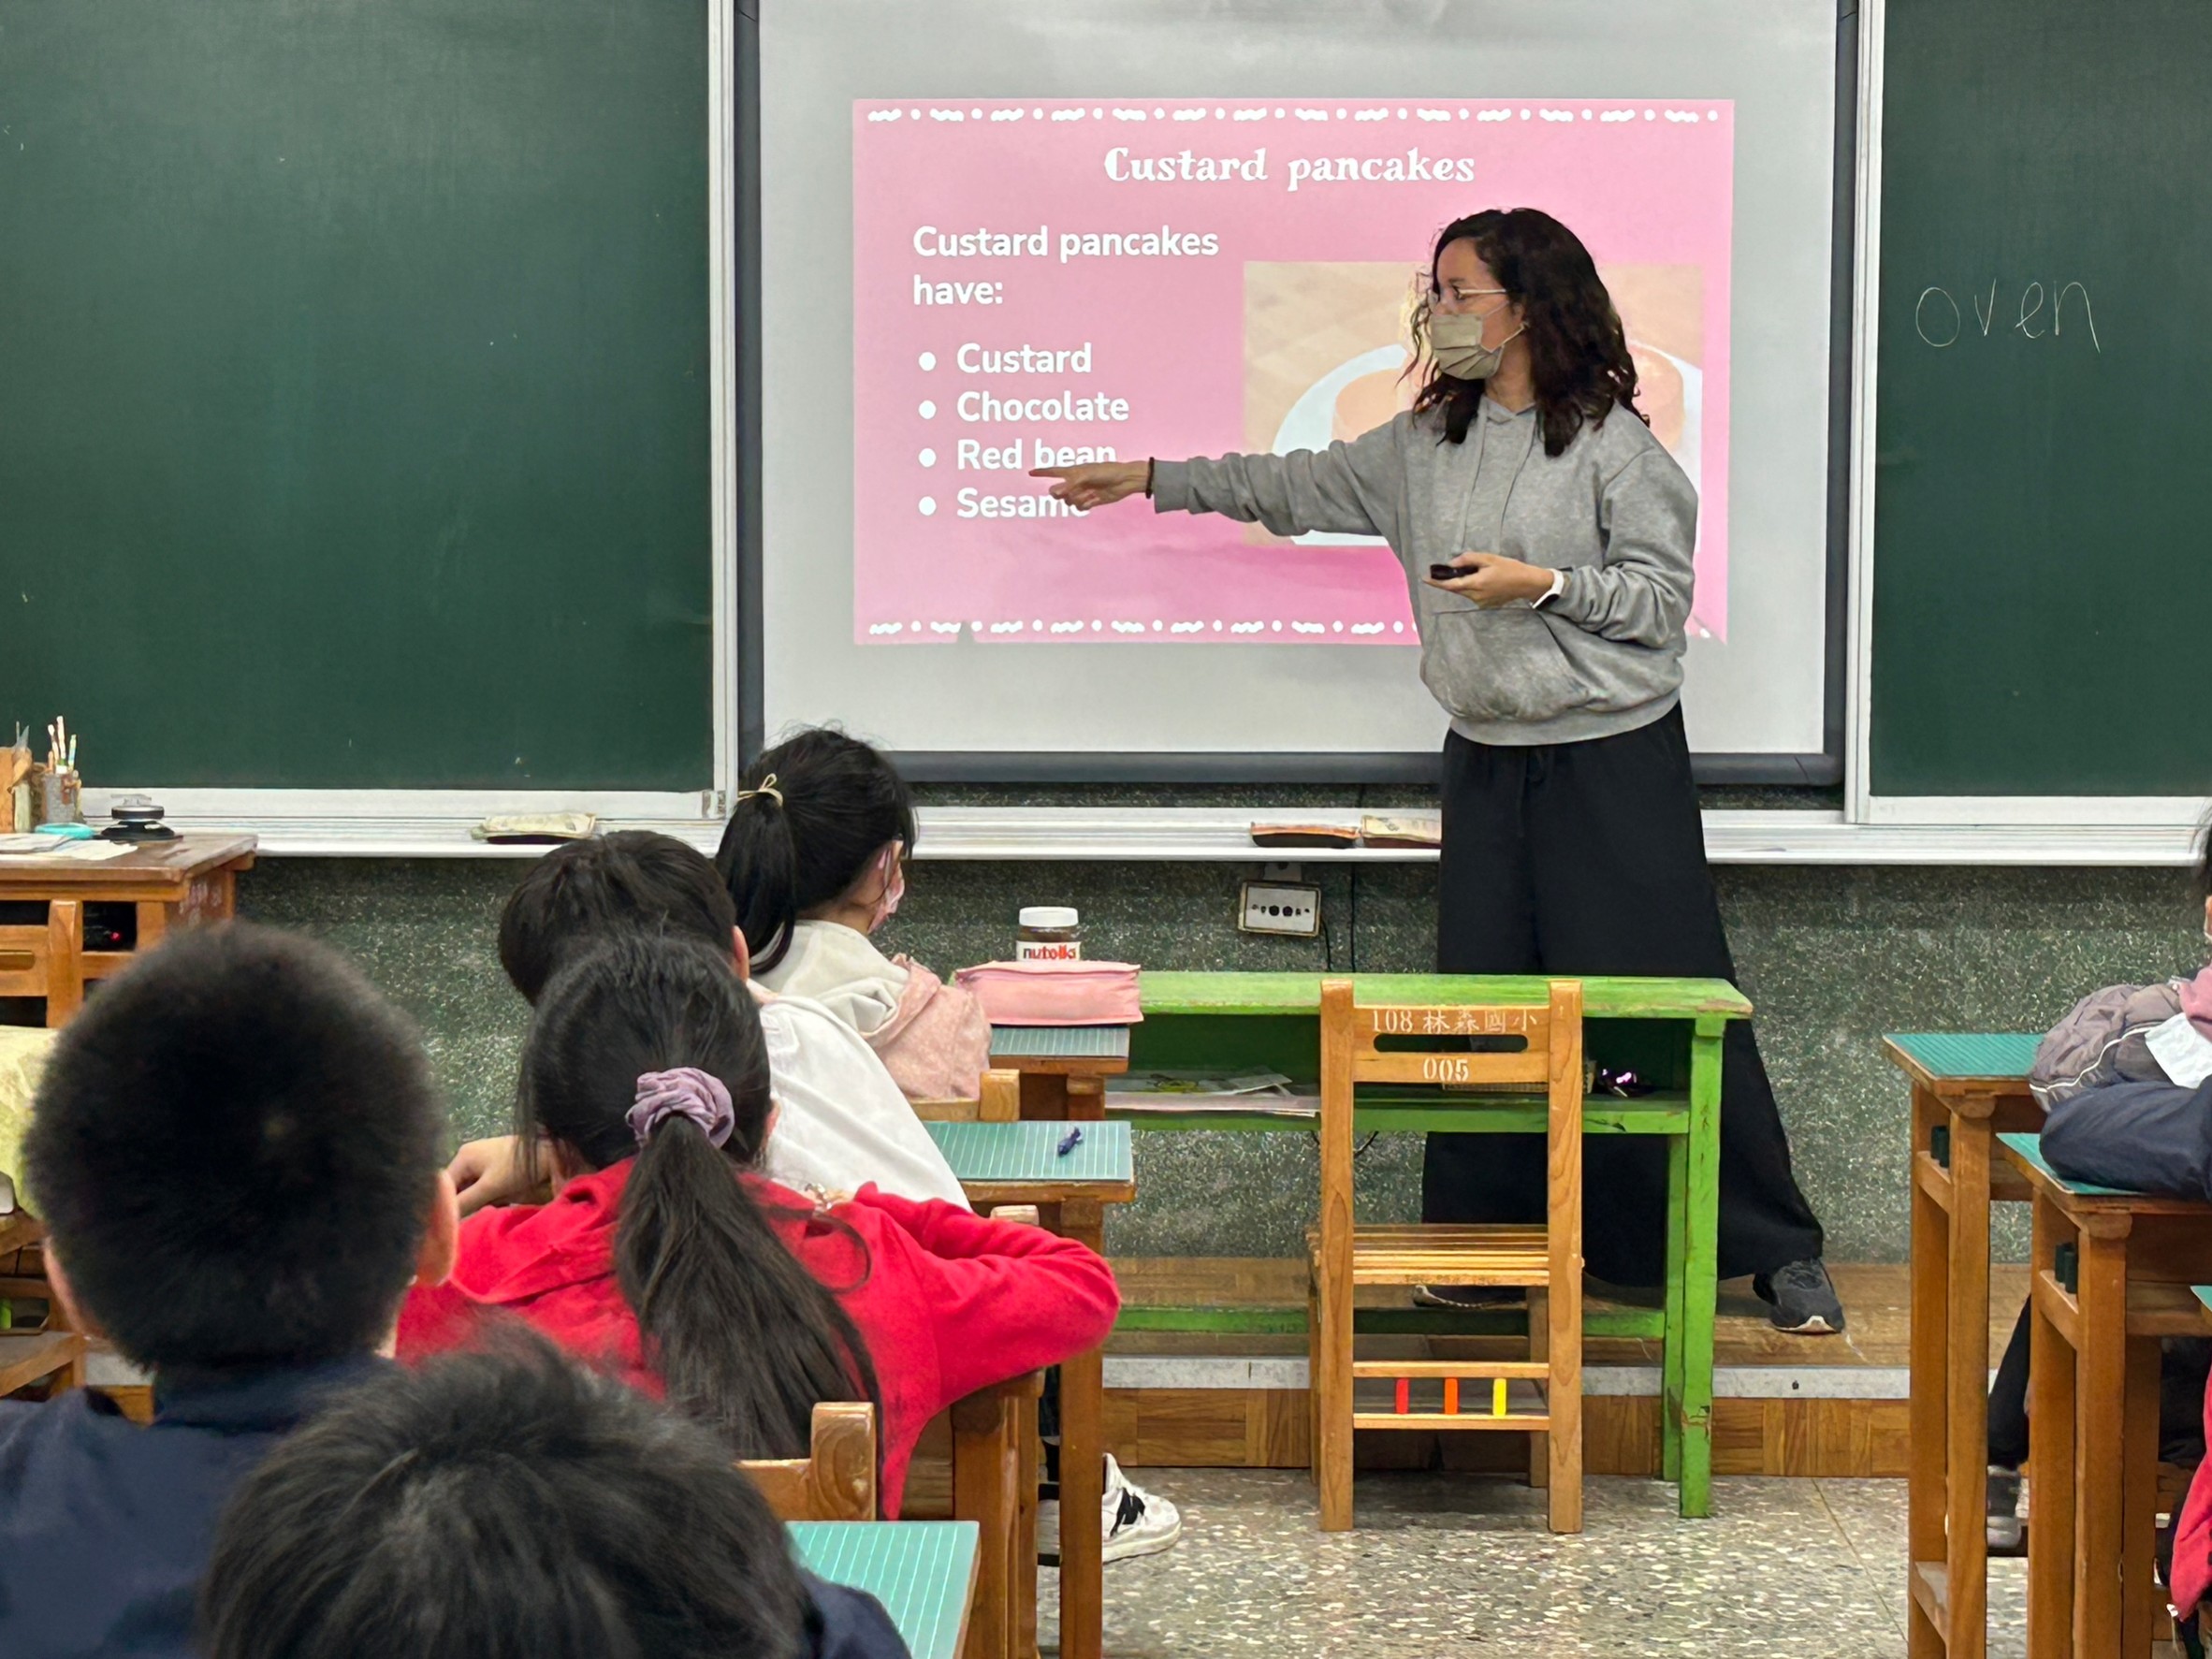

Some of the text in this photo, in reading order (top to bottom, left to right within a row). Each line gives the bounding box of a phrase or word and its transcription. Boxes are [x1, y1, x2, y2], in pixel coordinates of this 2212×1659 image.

[1103, 147, 1476, 192] Custard pancakes
[912, 225, 1219, 264] Custard pancakes
[913, 274, 1004, 306] have:
[1915, 278, 2102, 354] oven
[956, 342, 1093, 374] Custard
[956, 389, 1130, 422] Chocolate
[956, 438, 1117, 471] Red bean
[1023, 945, 1077, 960] nutella
[1373, 1009, 1537, 1034] 108 林森國小
[1422, 1057, 1470, 1082] 005
